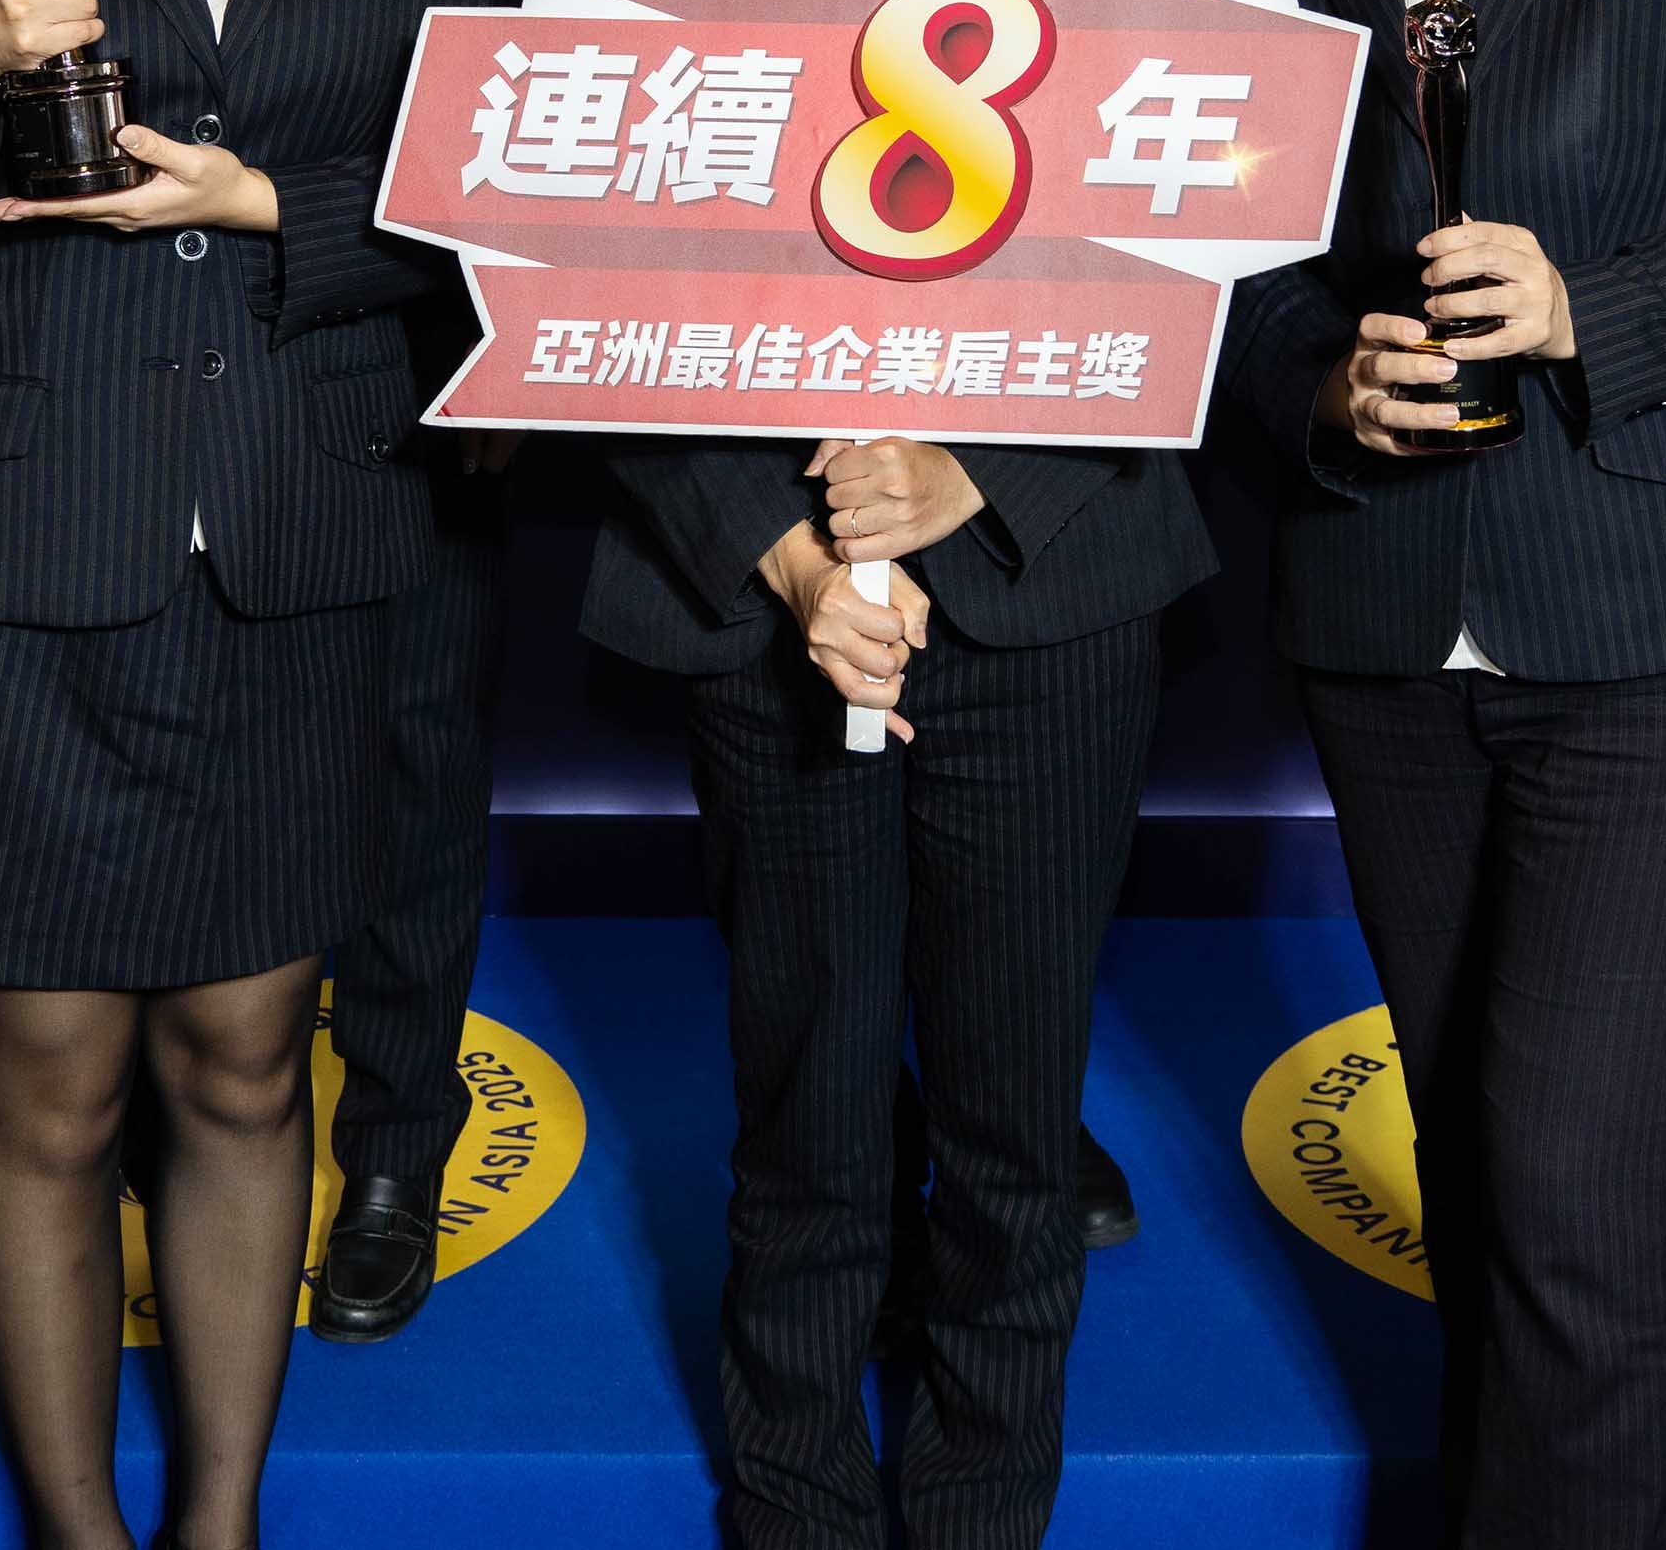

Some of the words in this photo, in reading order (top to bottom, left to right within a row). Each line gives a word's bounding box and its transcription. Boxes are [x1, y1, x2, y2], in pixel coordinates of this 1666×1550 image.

[522, 318, 1149, 402] 亞洲最佳企業雇主獎
[455, 1051, 534, 1112] 2025
[1302, 1053, 1388, 1112] BEST
[470, 1121, 538, 1193] ASIA
[438, 1199, 490, 1236] IN
[1291, 1119, 1430, 1265] COMPAN
